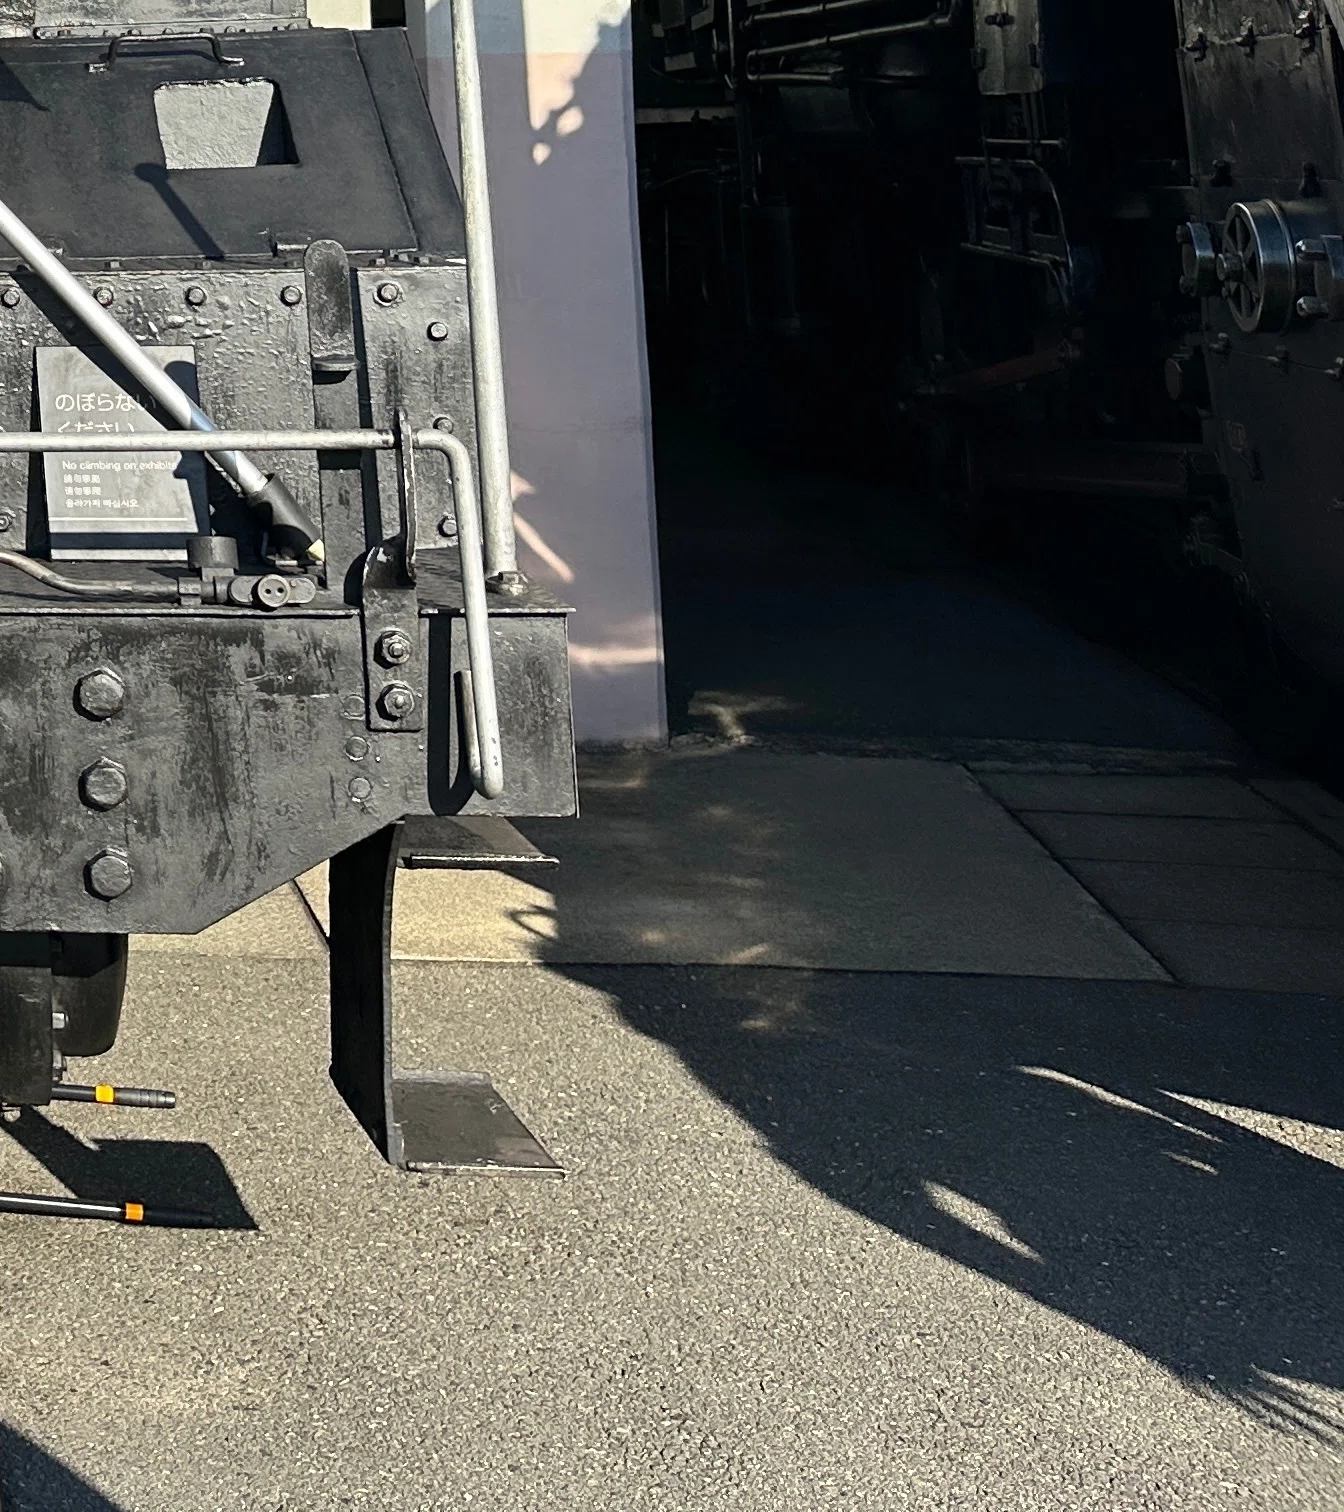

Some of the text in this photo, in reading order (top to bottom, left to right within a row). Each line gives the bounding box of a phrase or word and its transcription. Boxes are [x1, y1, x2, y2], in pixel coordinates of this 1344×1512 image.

[55, 392, 157, 412] のぼらない
[62, 460, 77, 470] No
[79, 460, 121, 472] climbing
[123, 462, 137, 470] on
